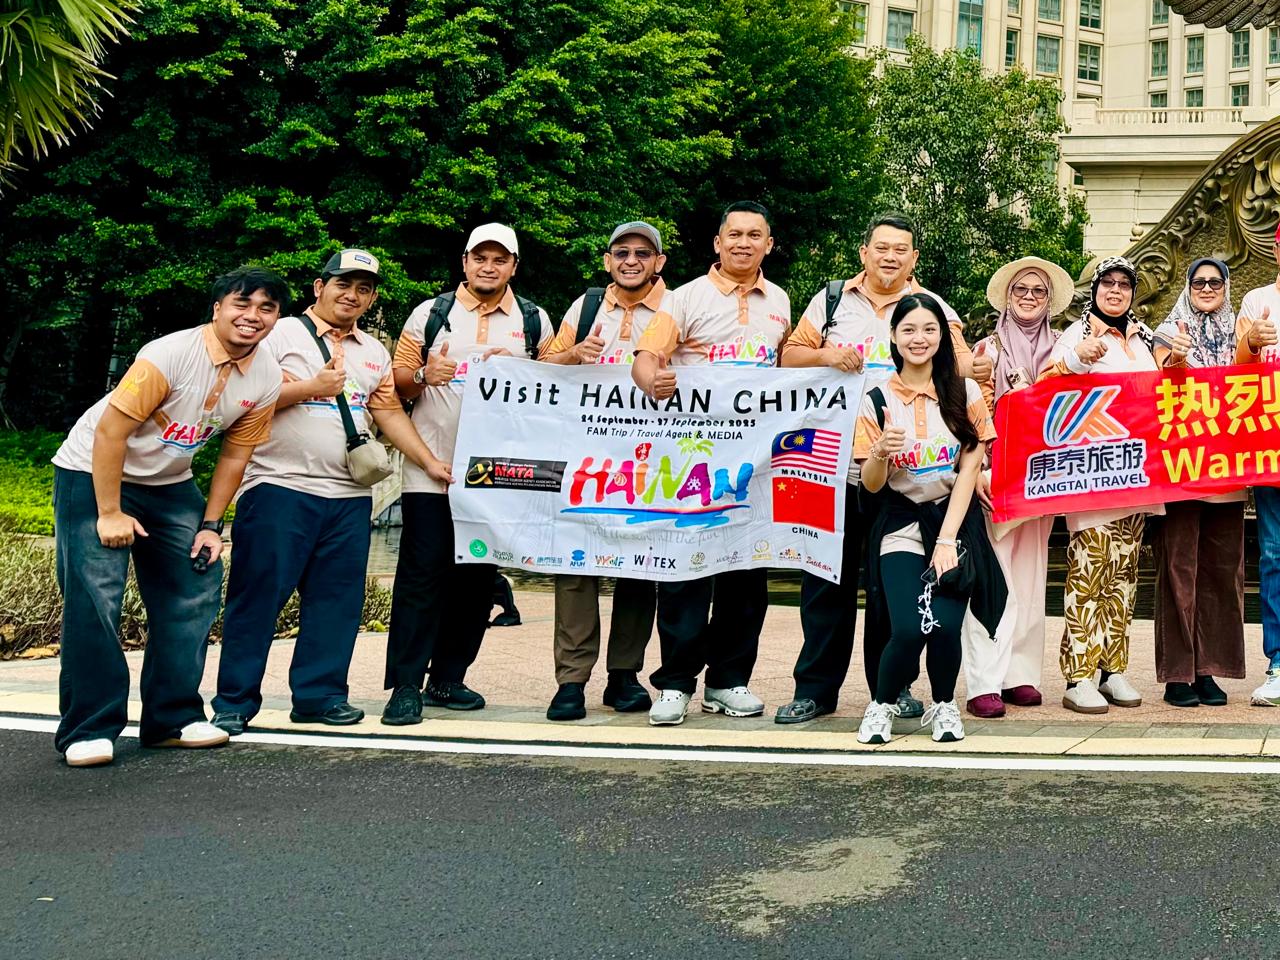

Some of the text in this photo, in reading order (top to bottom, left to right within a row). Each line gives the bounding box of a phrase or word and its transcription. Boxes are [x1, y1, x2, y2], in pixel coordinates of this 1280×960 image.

[478, 377, 560, 406] Visit
[732, 385, 848, 415] CHINA
[581, 414, 594, 423] 24
[597, 414, 648, 426] September
[657, 417, 669, 426] 27
[671, 417, 725, 428] September
[728, 419, 756, 428] 2025
[586, 426, 608, 437] FAM
[611, 427, 628, 438] Trip
[637, 429, 664, 438] Travel
[664, 429, 692, 440] Agent
[707, 431, 743, 440] MEDIA
[1027, 441, 1144, 482] 康泰旅游
[494, 463, 534, 479] MATA
[781, 468, 828, 484] MALAYSIA
[1028, 472, 1147, 497] KANGTAI TRAVEL
[791, 526, 819, 540] CHINA
